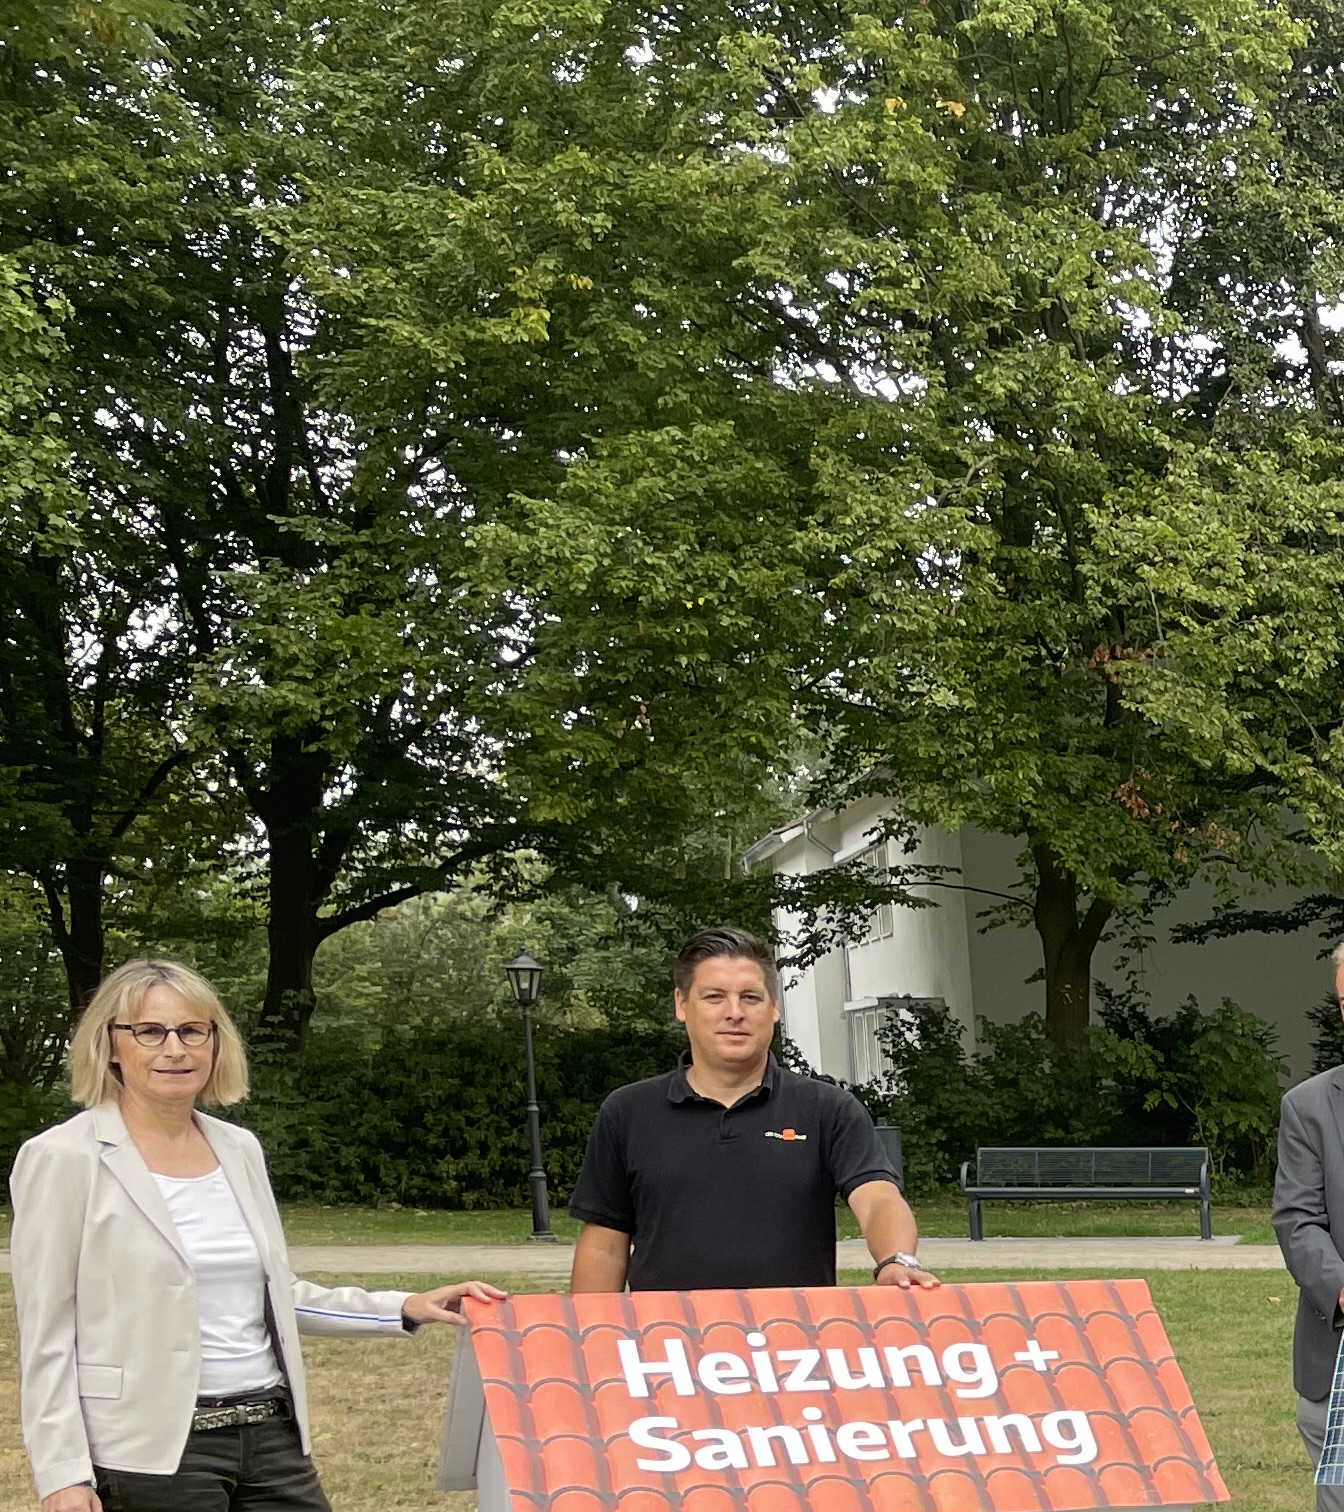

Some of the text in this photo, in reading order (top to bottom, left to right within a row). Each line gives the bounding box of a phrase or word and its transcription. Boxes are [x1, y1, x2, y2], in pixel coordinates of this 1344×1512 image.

[617, 1333, 1060, 1399] Heizung +
[628, 1404, 1098, 1473] Sanierung
